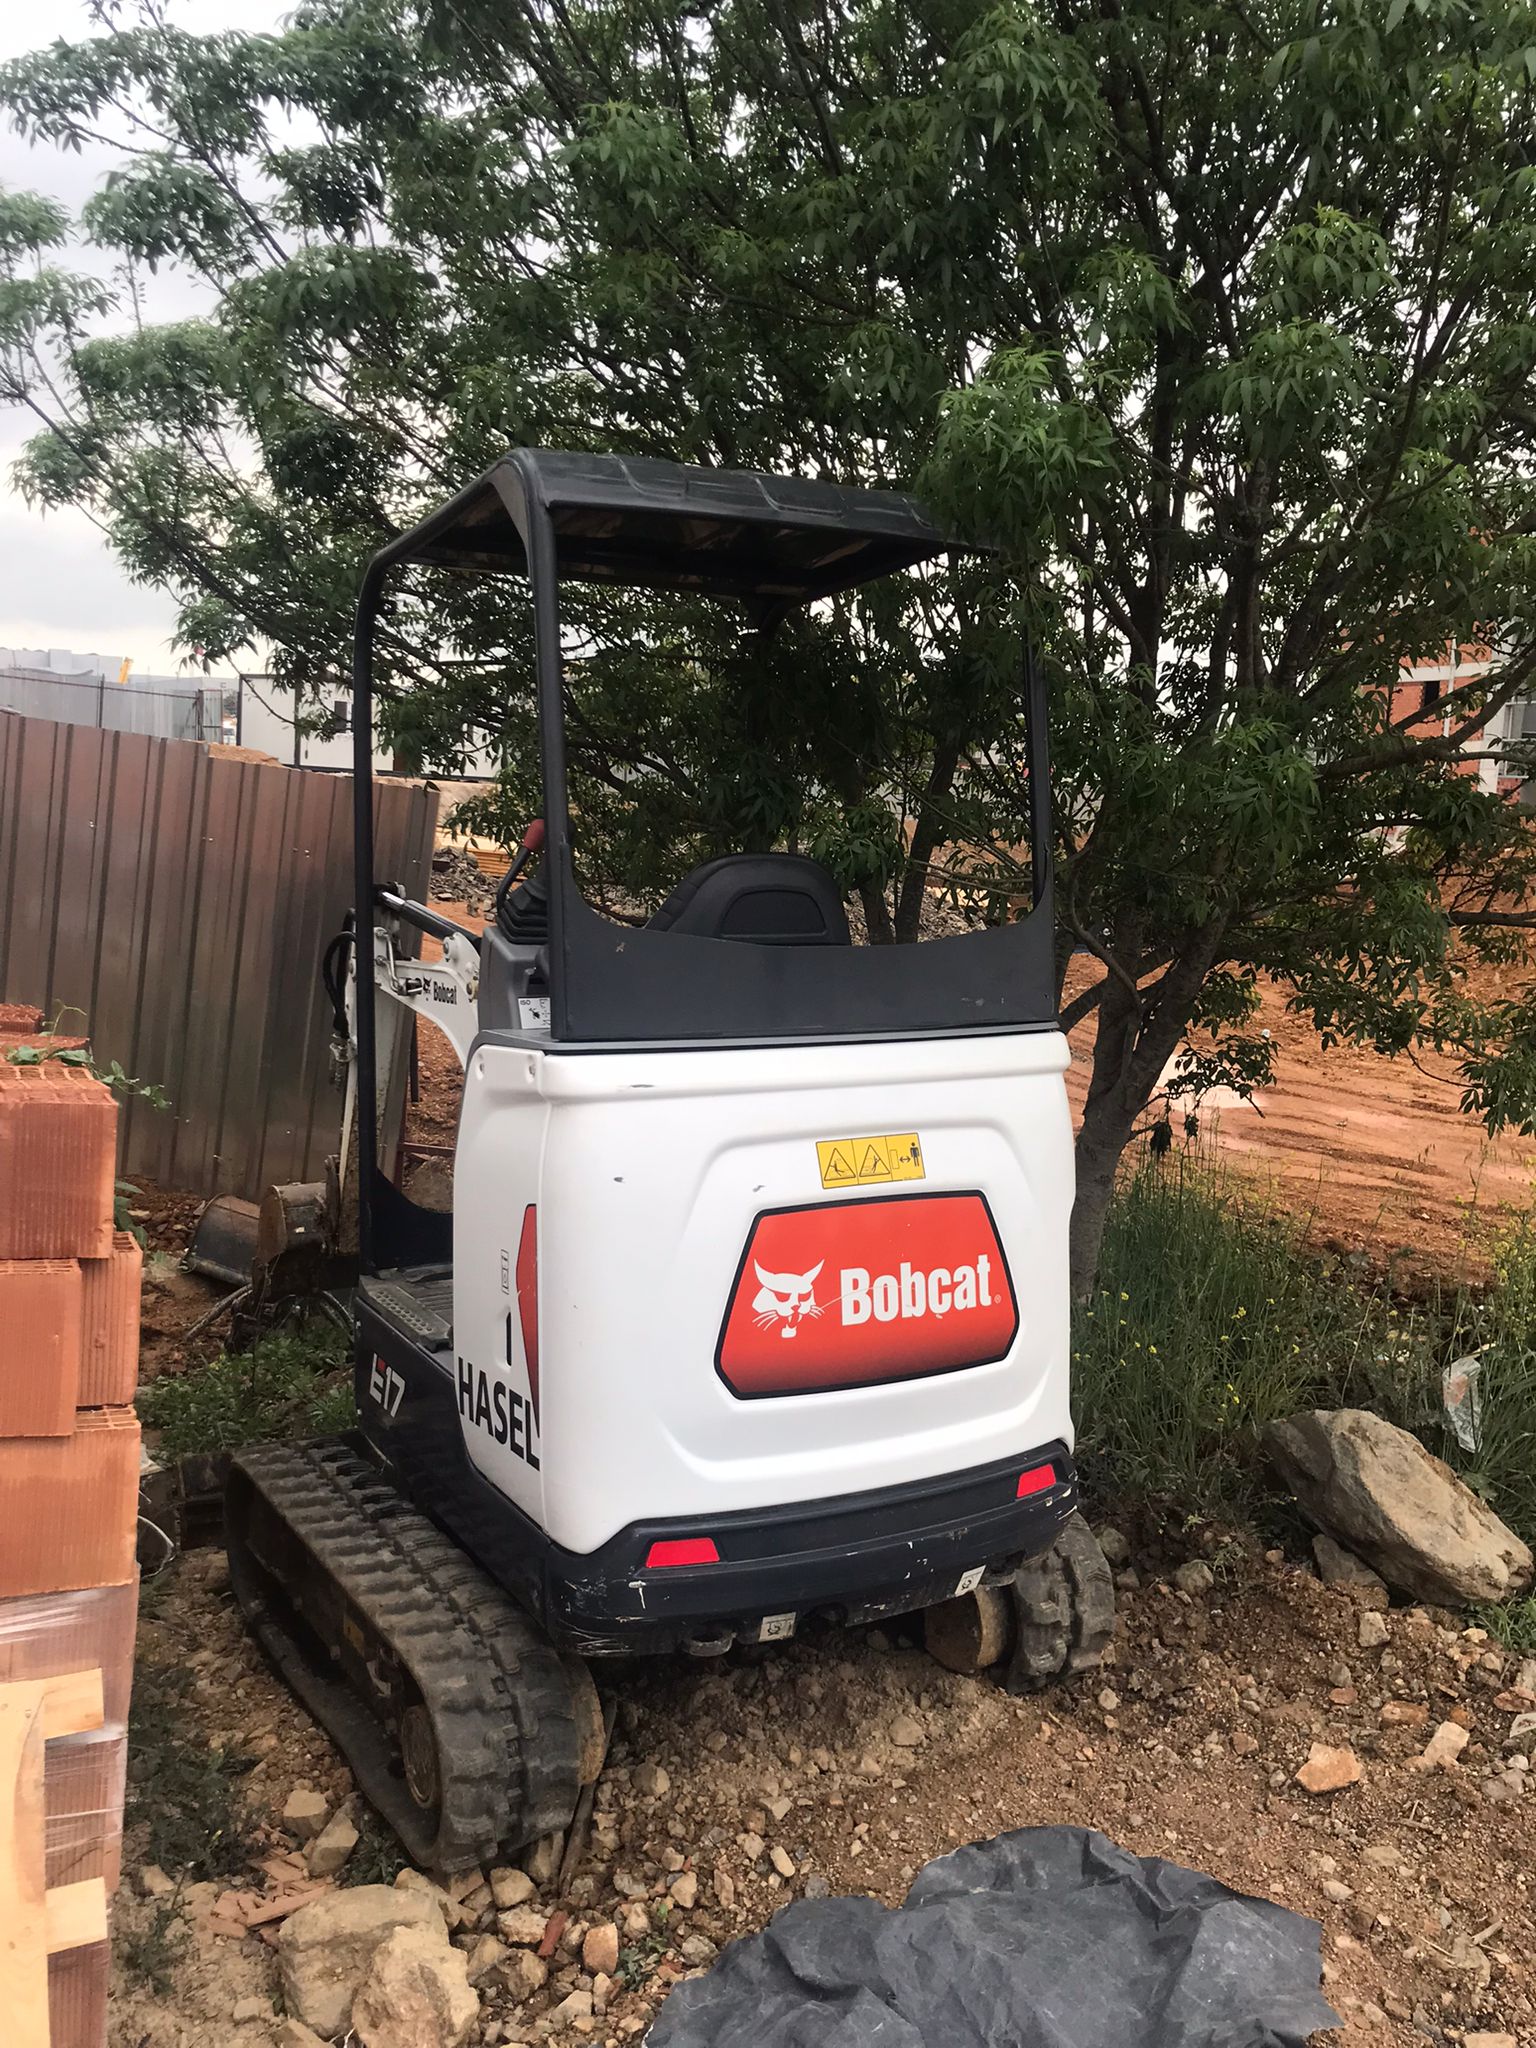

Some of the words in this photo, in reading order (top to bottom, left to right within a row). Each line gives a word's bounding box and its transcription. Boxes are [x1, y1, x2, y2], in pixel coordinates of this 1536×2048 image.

[433, 981, 458, 1005] Bobcat
[840, 1254, 992, 1327] Bobcat
[369, 1353, 406, 1418] E17
[458, 1356, 541, 1472] HASEL
